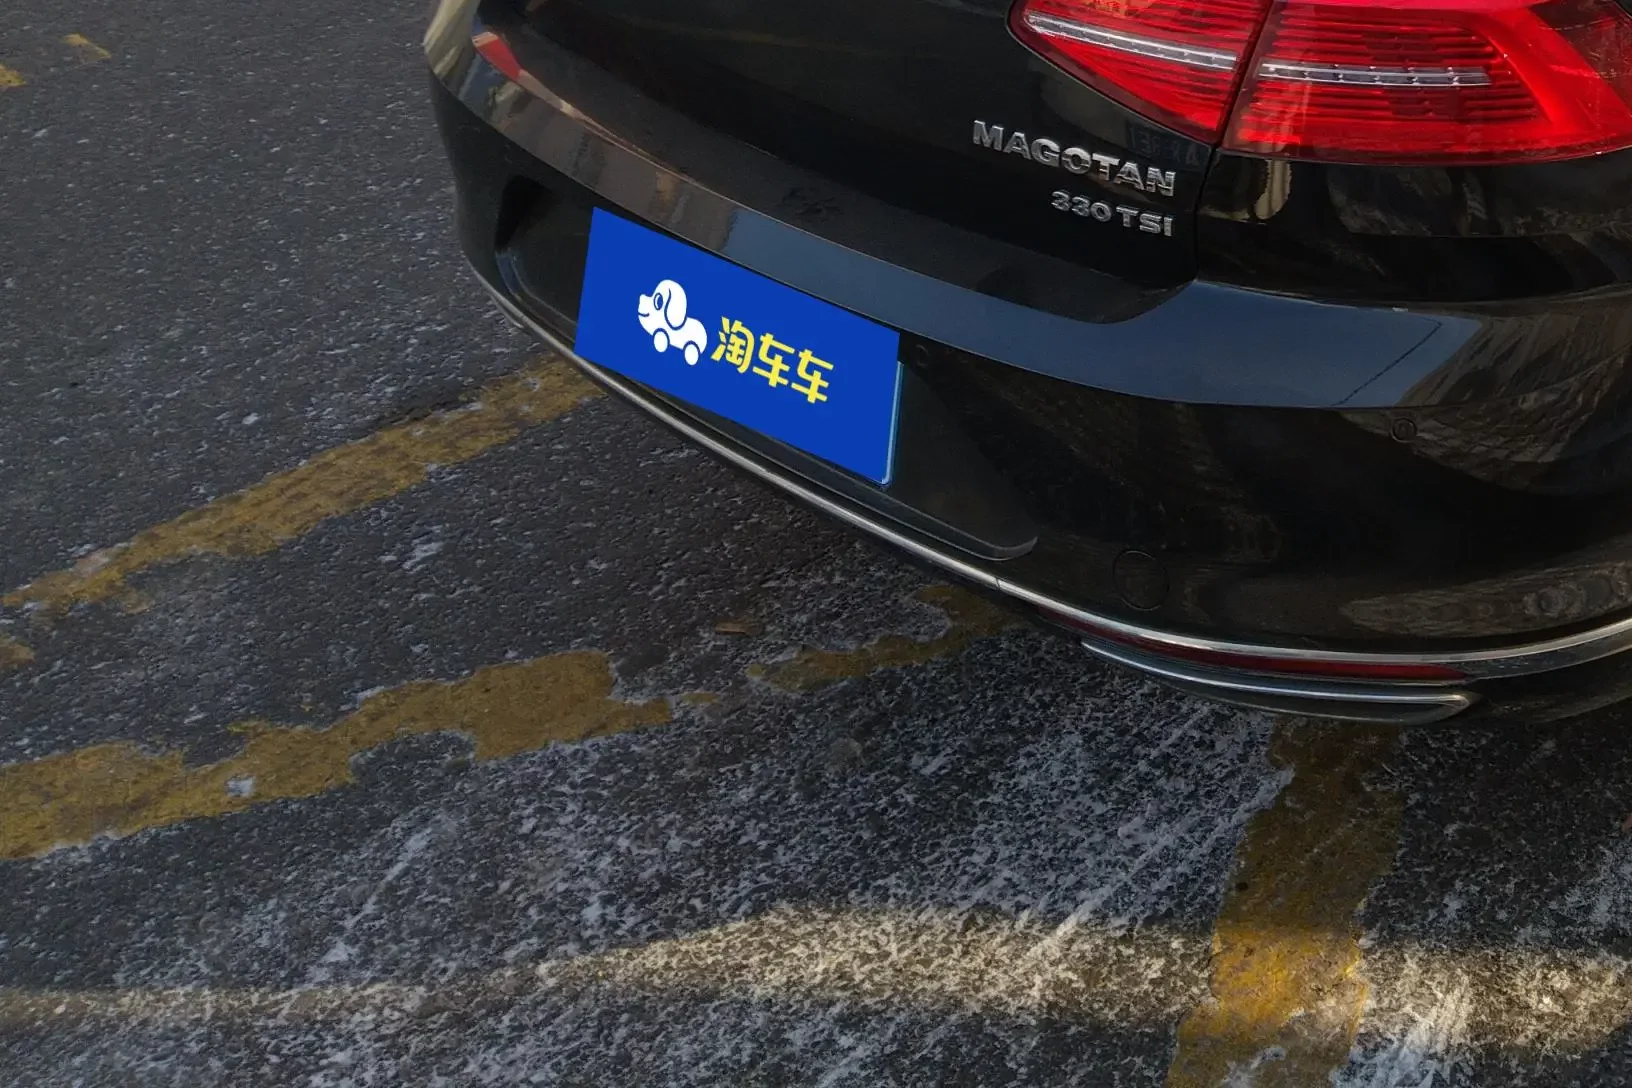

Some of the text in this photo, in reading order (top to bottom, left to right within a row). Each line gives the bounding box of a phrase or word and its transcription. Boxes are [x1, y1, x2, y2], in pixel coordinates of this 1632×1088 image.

[973, 120, 1176, 197] MAGOTAN
[1050, 190, 1174, 237] 330 TSI
